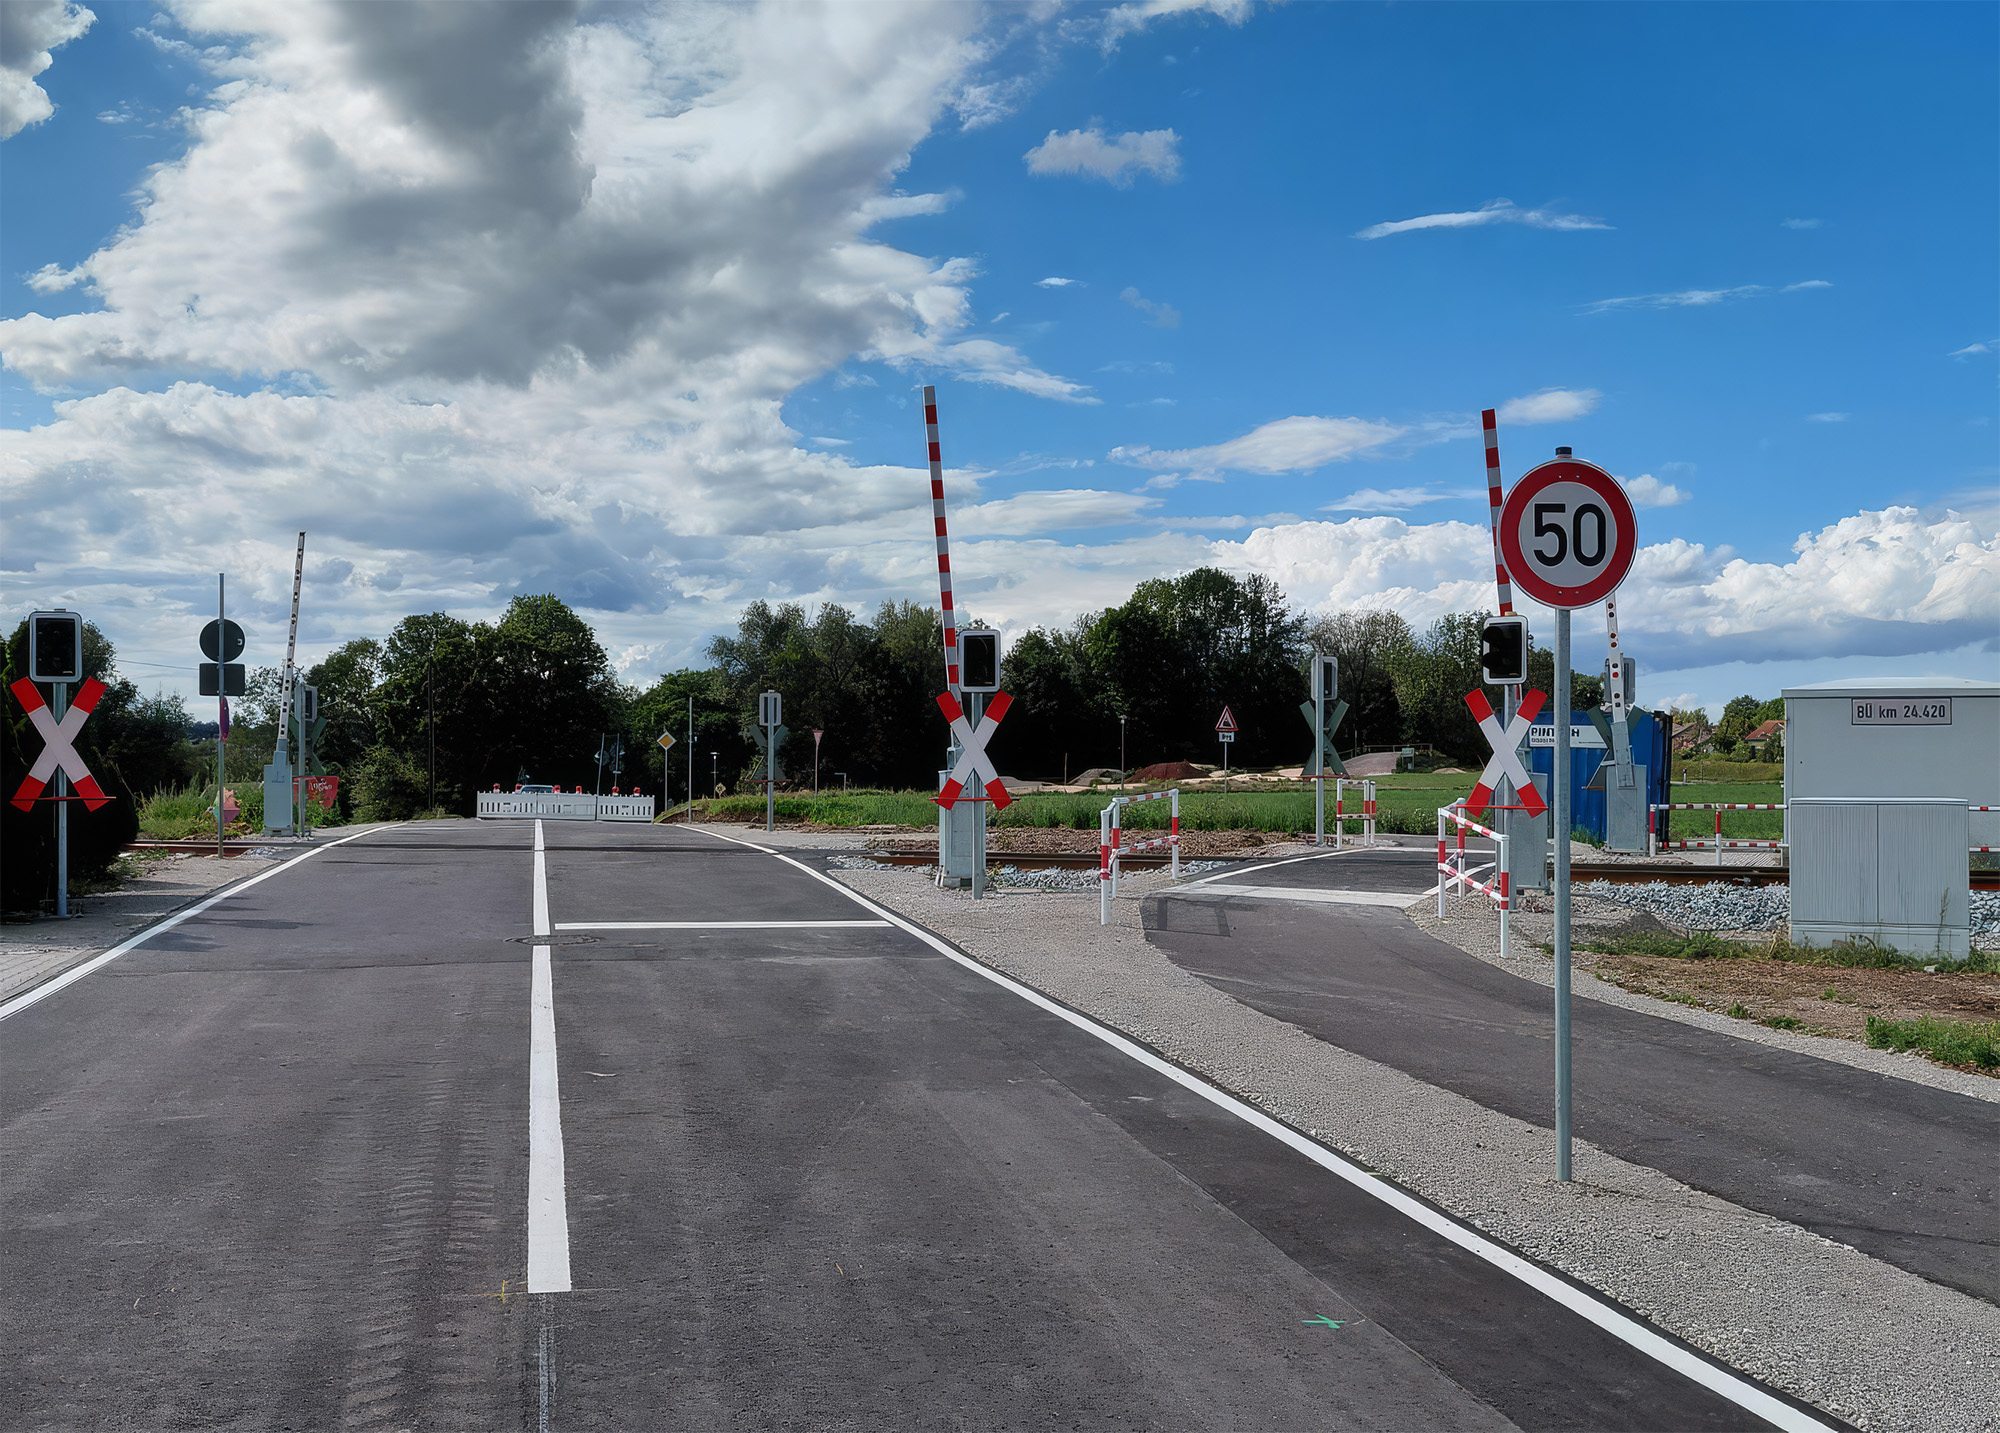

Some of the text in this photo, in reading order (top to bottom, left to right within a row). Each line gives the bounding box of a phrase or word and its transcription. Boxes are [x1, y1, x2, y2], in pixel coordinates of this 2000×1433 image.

[1533, 503, 1606, 567] 50
[1879, 705, 1897, 718] km
[1903, 705, 1946, 718] 24.420
